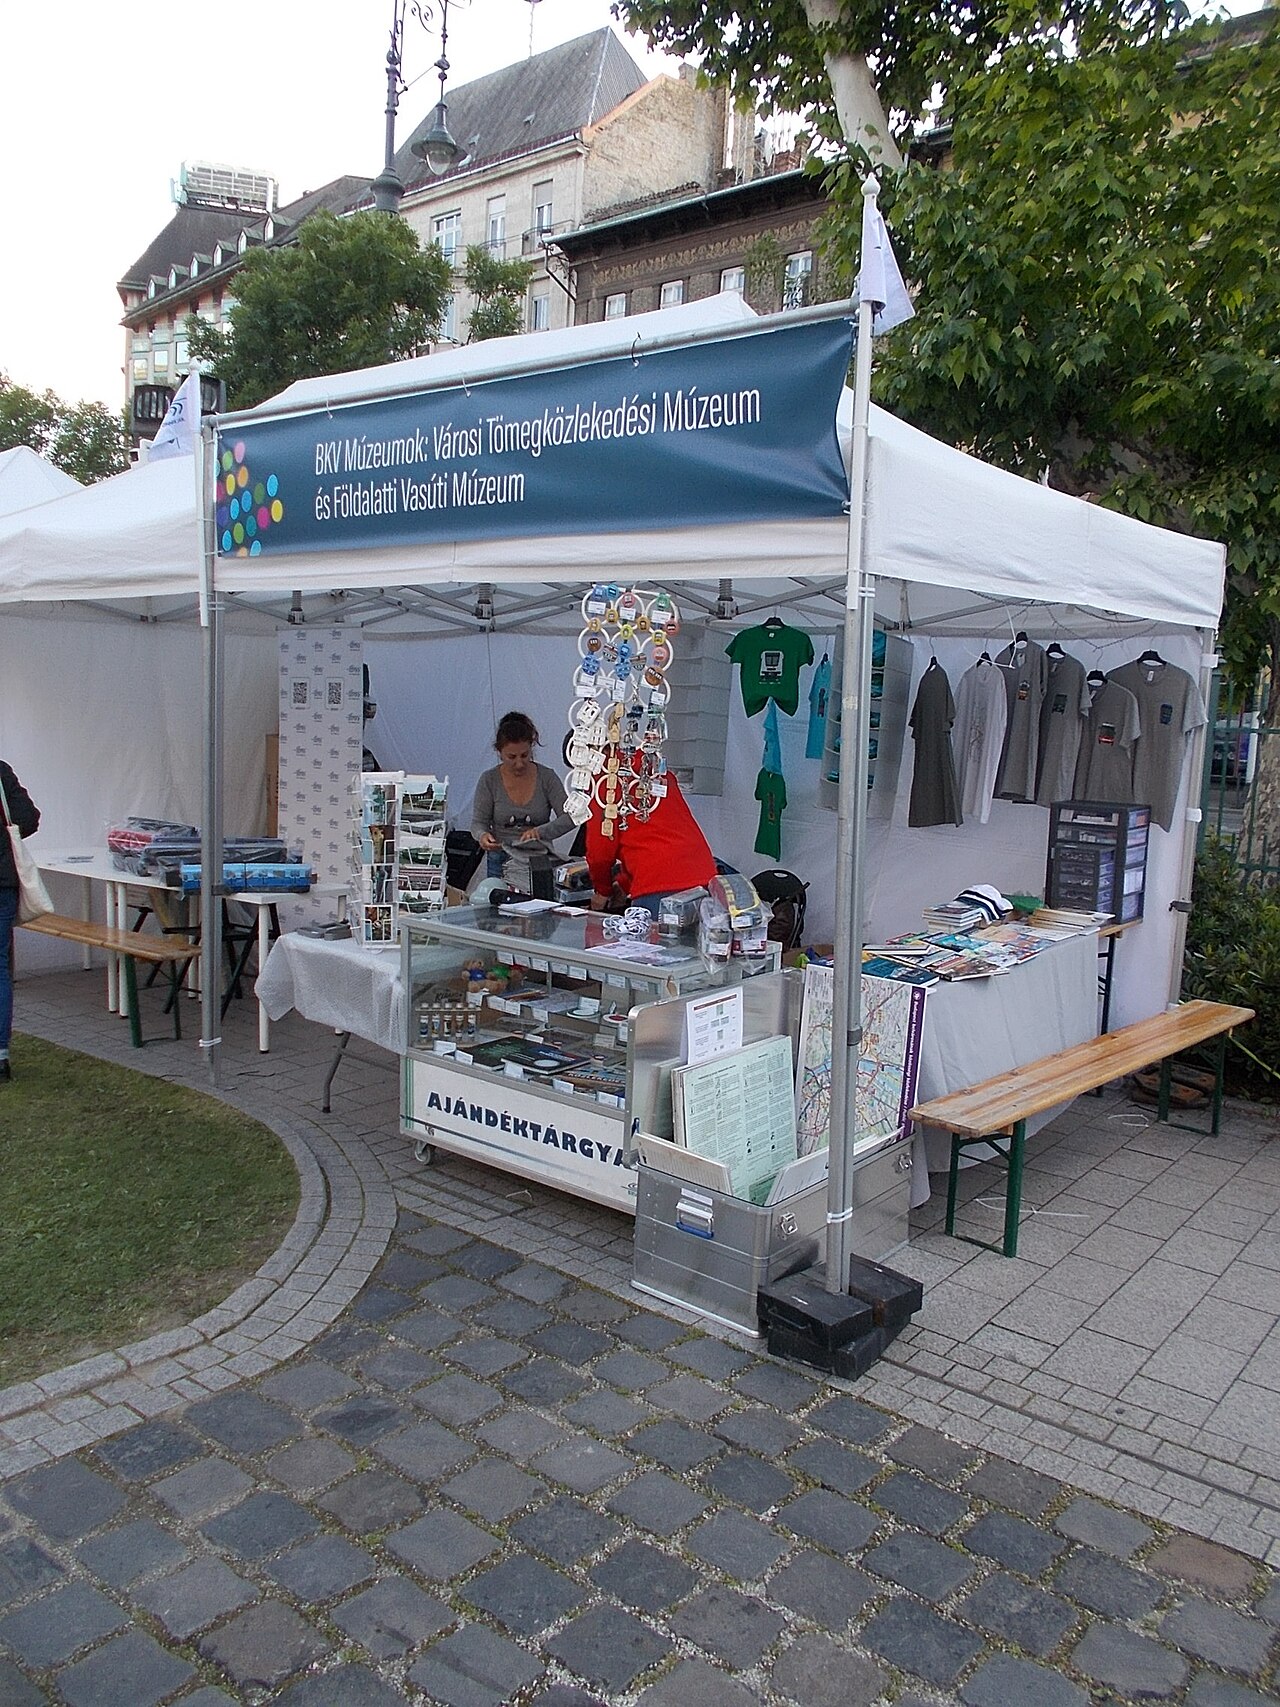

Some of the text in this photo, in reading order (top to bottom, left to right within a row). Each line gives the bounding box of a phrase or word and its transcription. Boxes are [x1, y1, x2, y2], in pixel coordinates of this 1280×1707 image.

[315, 386, 760, 475] BKV Múzeumok: Városi Tömegközlekedési Múzeum
[315, 468, 525, 520] és Földalatti Vasúti Múzeum
